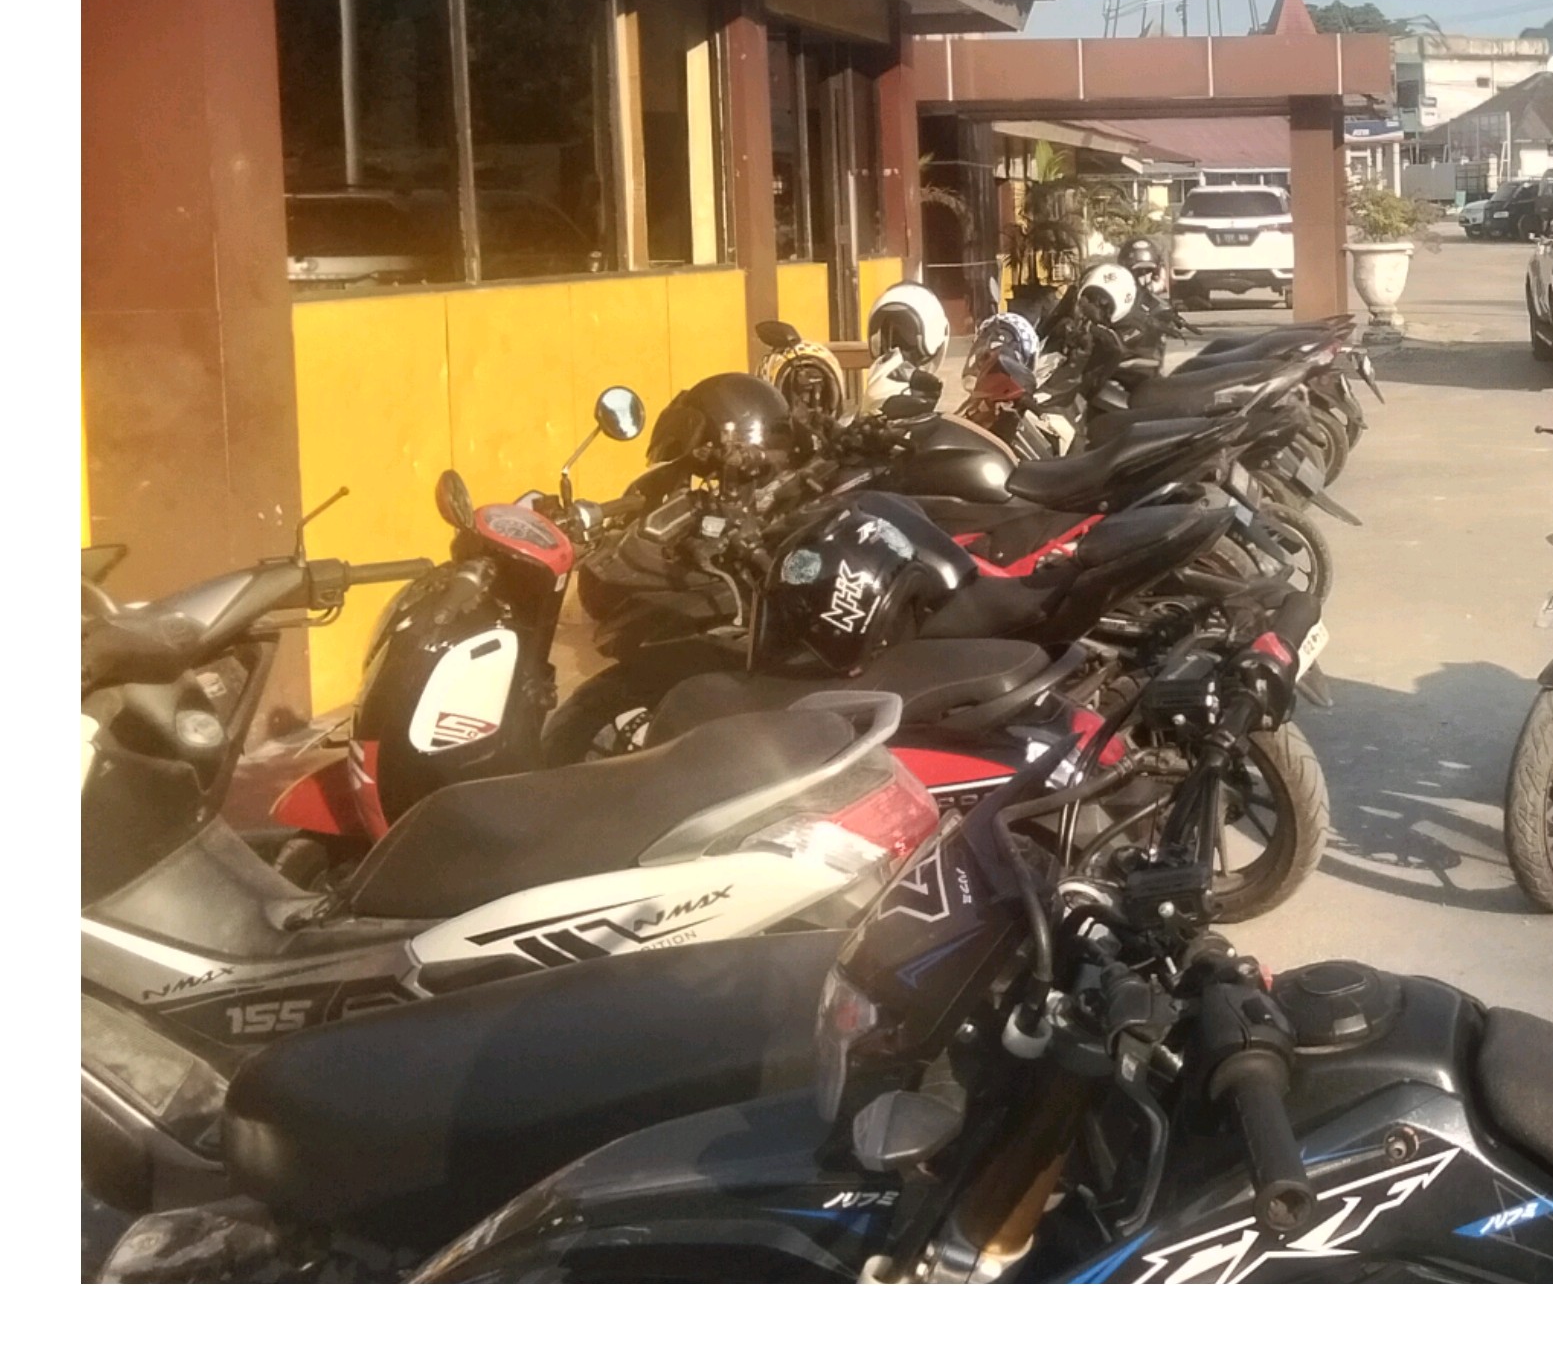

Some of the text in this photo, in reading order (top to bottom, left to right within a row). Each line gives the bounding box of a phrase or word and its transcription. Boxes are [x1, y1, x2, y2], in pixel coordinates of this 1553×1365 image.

[820, 558, 866, 634] NHK
[633, 884, 734, 931] NMAX
[142, 965, 236, 1001] NMAX
[226, 998, 313, 1034] 155
